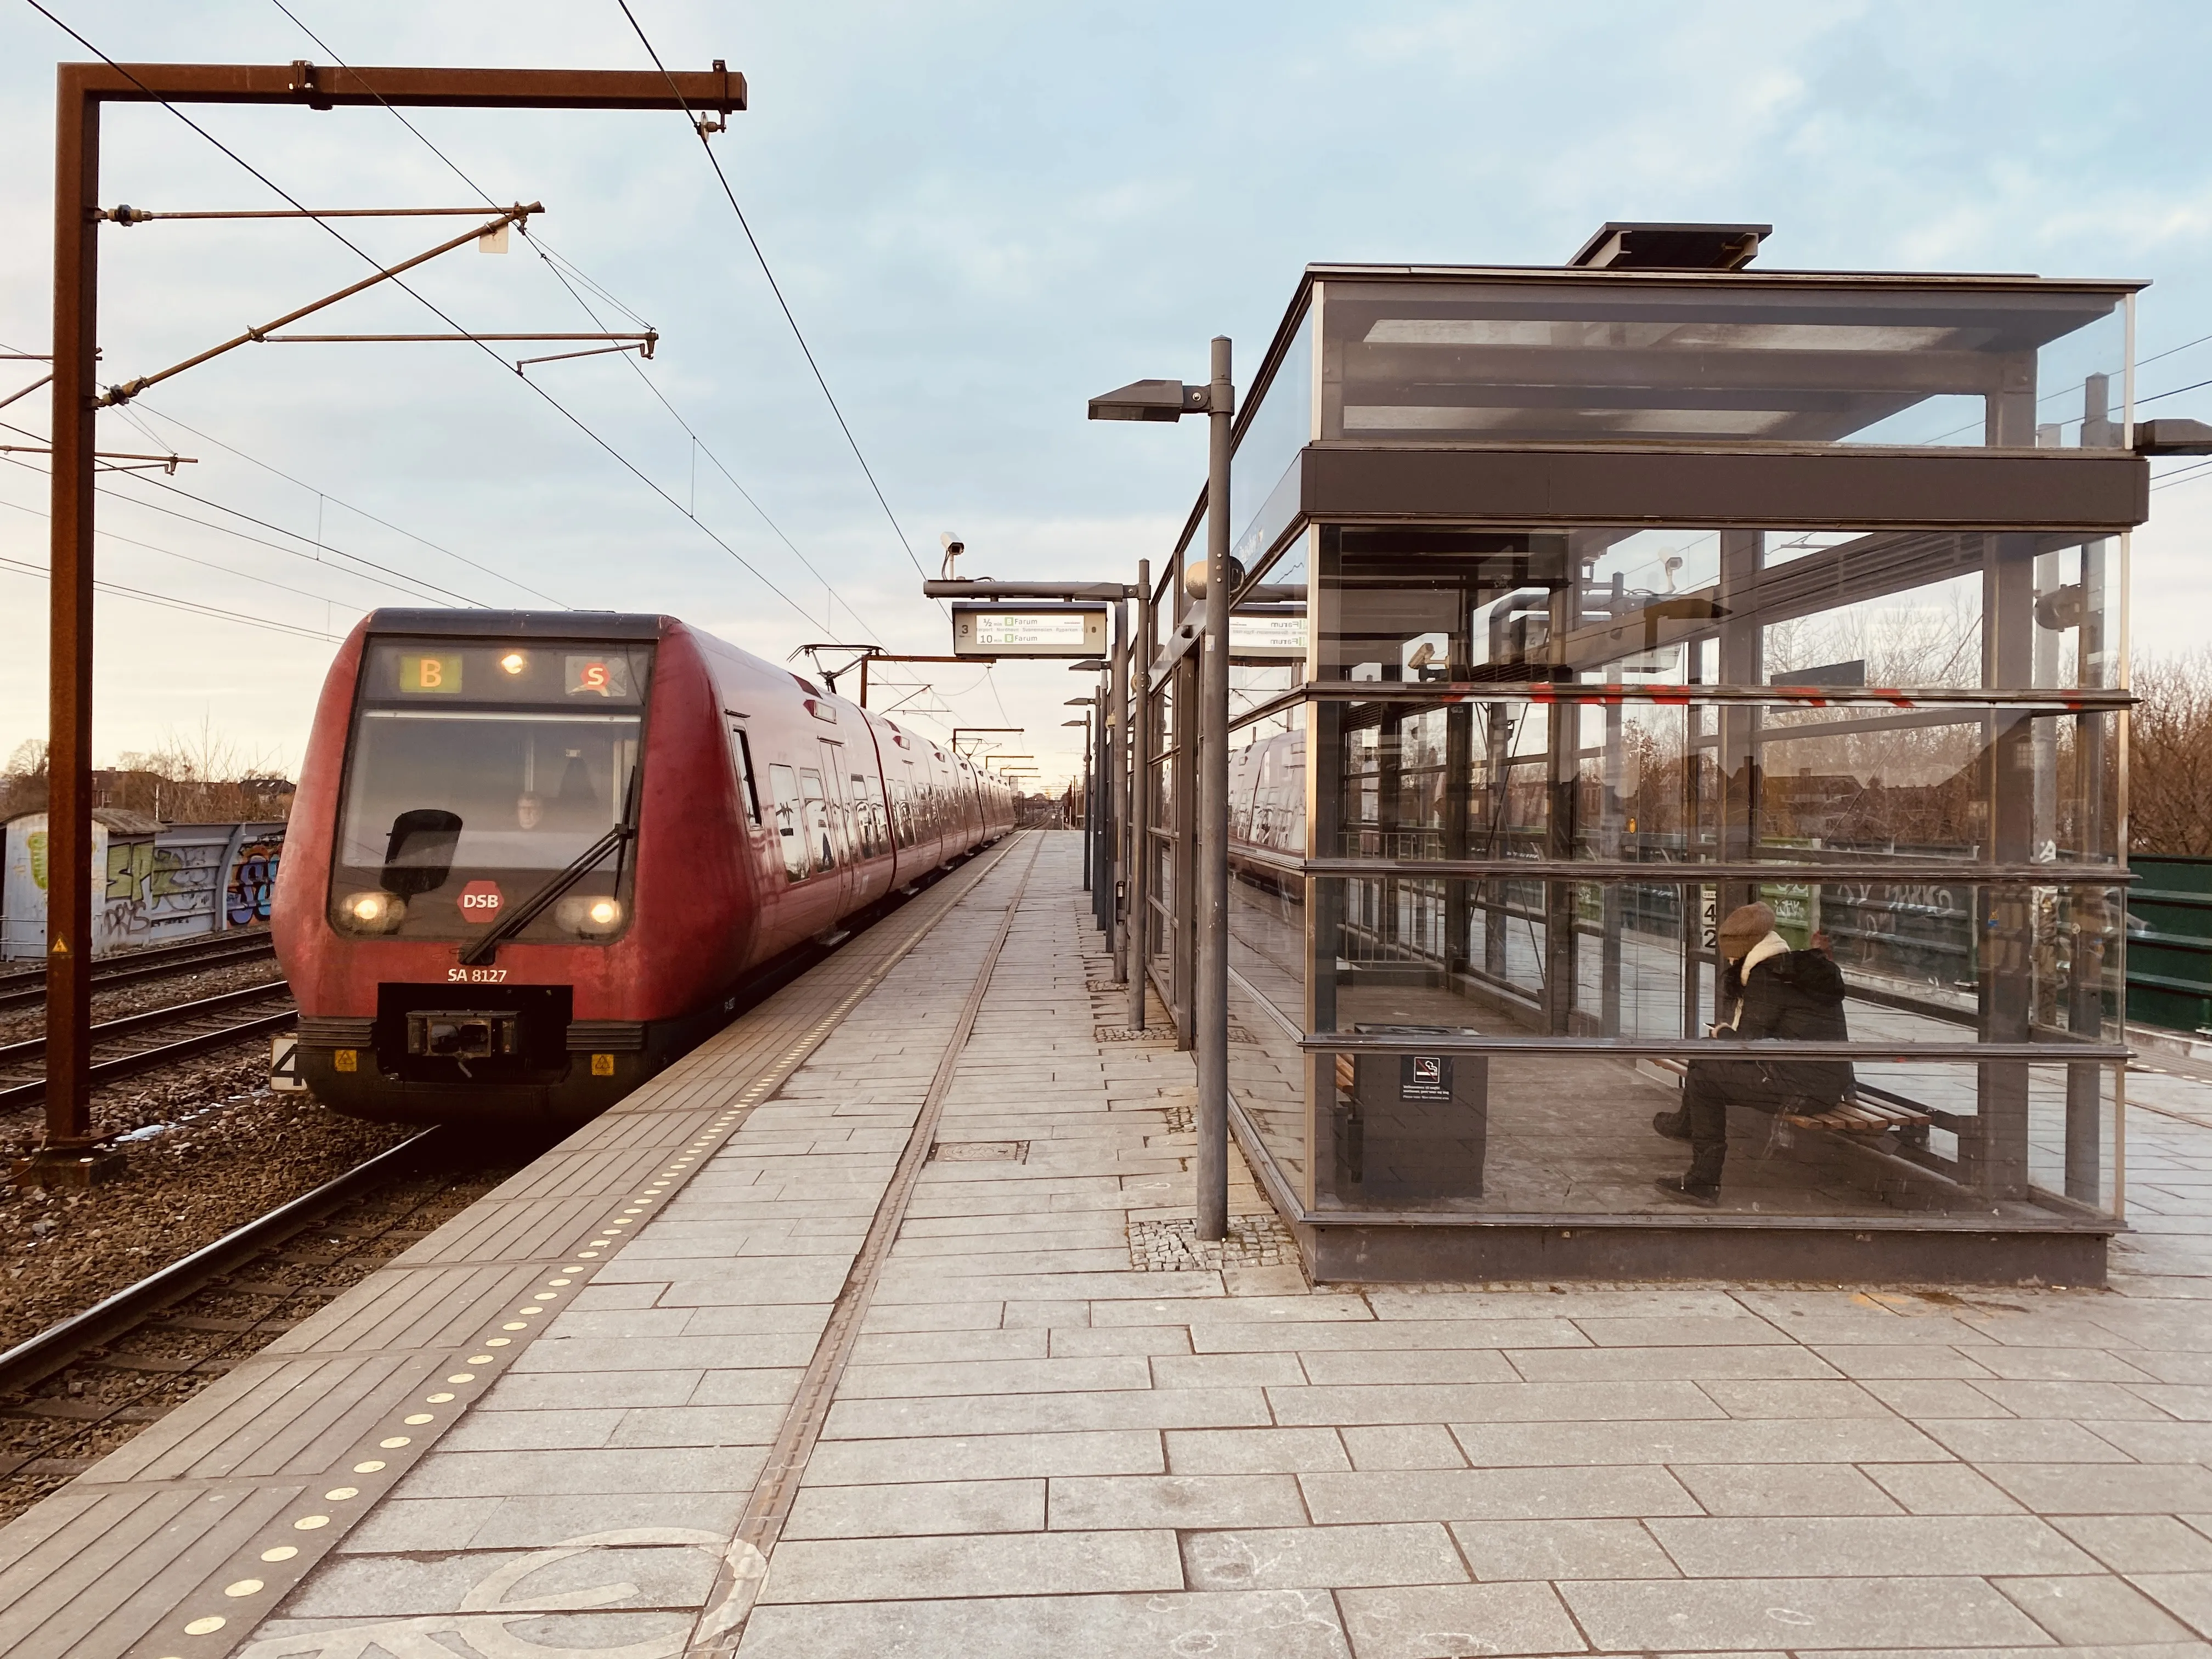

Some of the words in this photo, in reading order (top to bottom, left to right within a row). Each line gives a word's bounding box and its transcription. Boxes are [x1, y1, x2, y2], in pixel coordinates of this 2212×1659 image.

[962, 625, 968, 634] 3
[980, 635, 992, 643] 10
[420, 659, 442, 687] B
[588, 667, 605, 685] S
[463, 894, 499, 909] DSB
[1704, 904, 1716, 922] 4
[1704, 929, 1716, 949] 2
[447, 968, 467, 982] SA
[472, 969, 507, 983] 8127
[272, 1043, 303, 1086] 4
